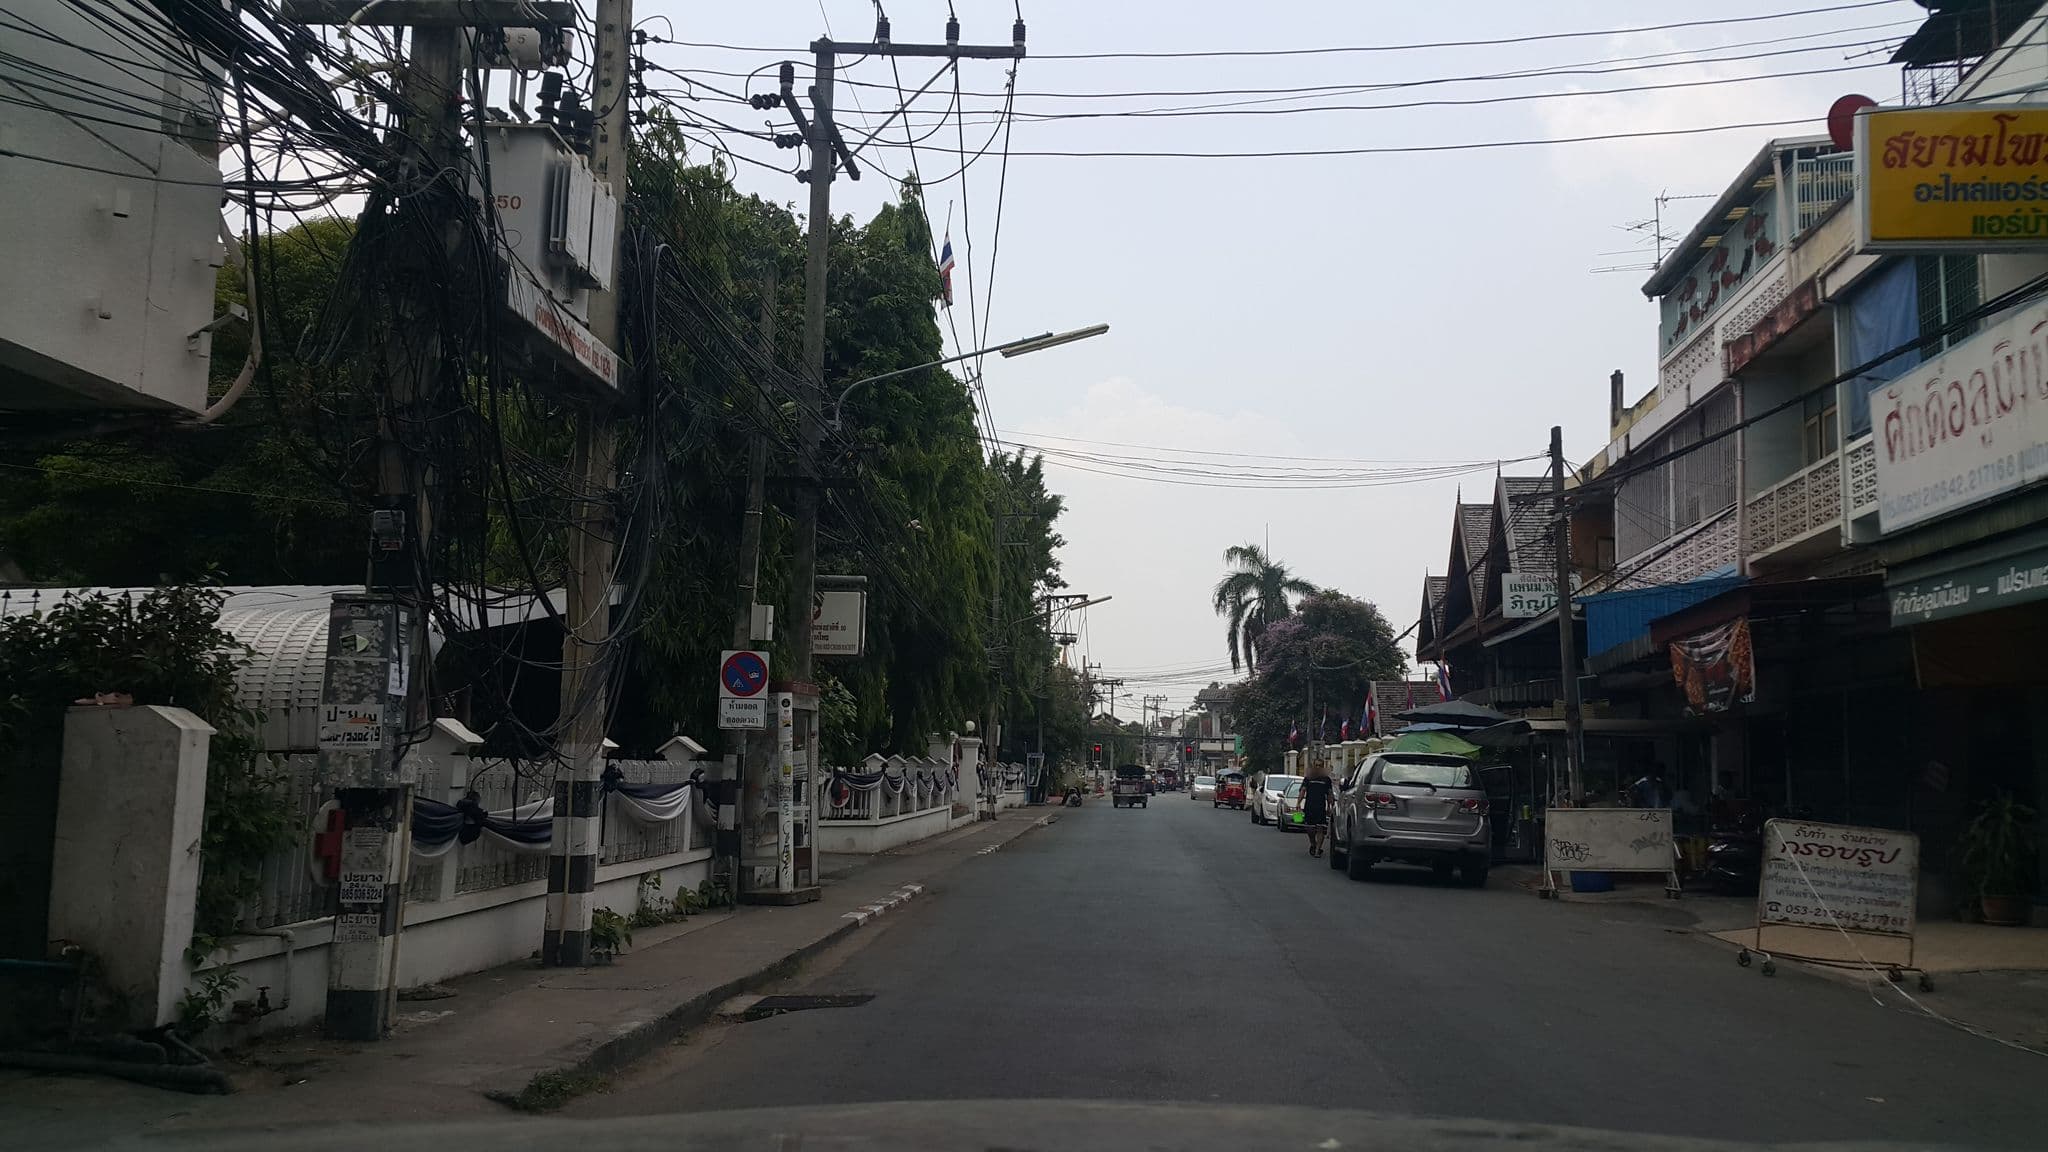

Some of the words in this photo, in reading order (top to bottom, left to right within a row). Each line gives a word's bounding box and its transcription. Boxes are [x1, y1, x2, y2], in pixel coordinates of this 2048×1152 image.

[1882, 113, 2048, 169] สยามโพ
[1510, 594, 1559, 613] ภิญโ
[728, 699, 759, 711] ห้ามจอด
[1780, 840, 1901, 868] กรอบรูป
